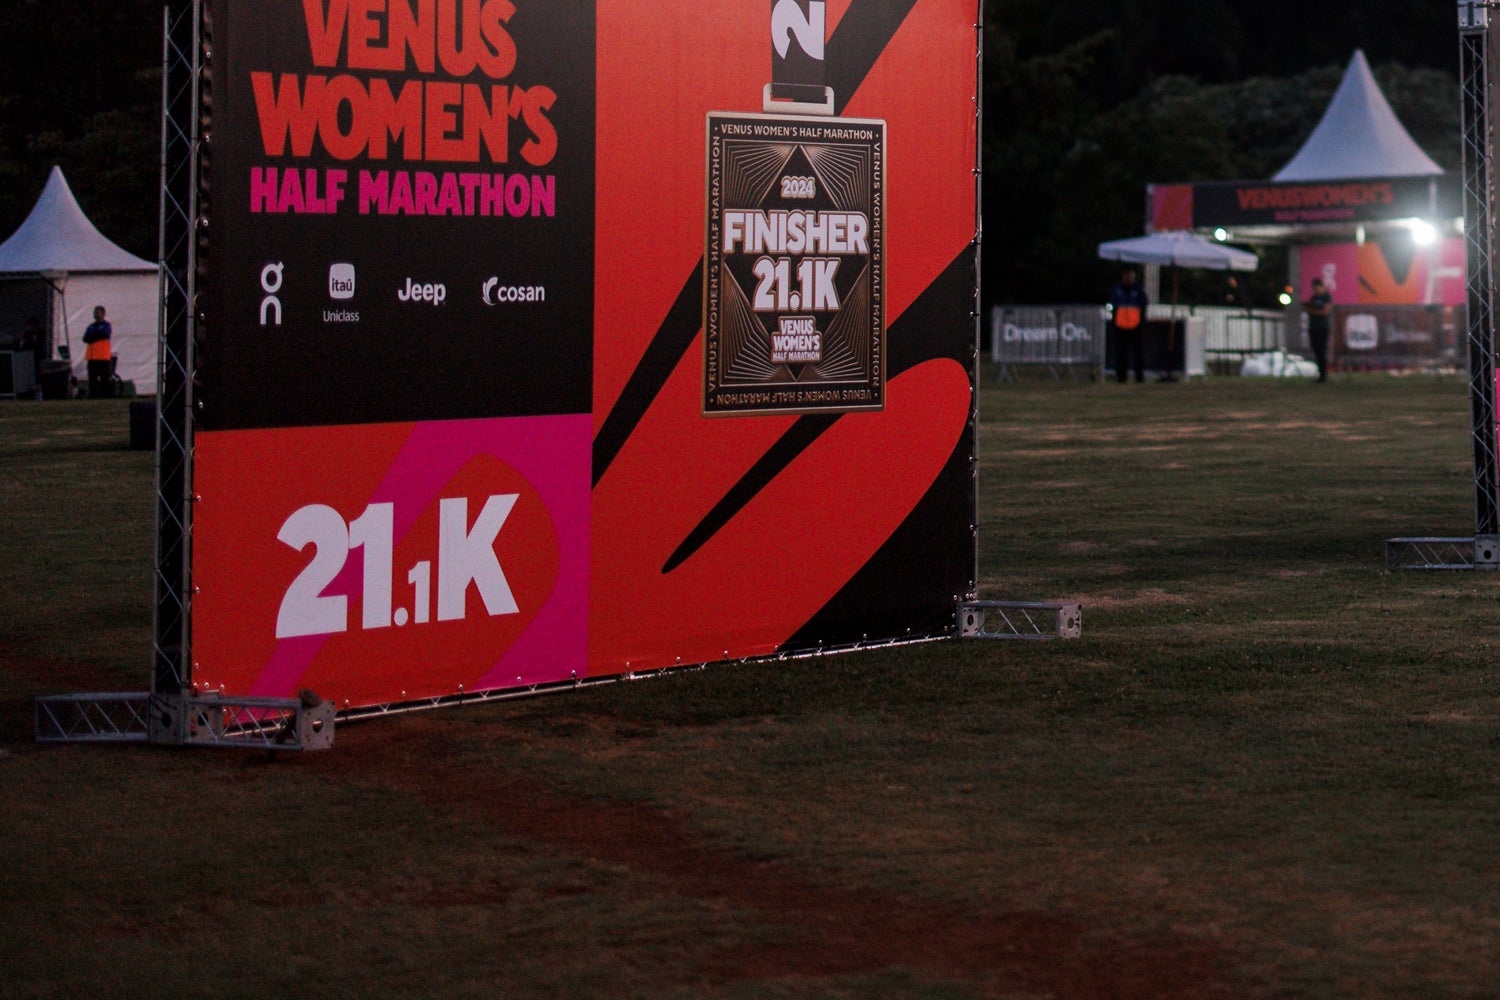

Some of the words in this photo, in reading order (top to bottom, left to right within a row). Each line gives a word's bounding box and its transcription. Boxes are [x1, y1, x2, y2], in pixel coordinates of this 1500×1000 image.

[250, 71, 558, 166] WOMEN'S
[721, 123, 752, 135] VENUS
[754, 125, 797, 137] WOMEN'S
[799, 127, 822, 138] HALF
[823, 128, 873, 140] MARATHON
[712, 136, 720, 220] MARATHON
[873, 142, 881, 192] VENUS
[250, 166, 348, 213] HALF
[359, 169, 556, 217] MARATHON
[782, 177, 815, 197] 2024
[710, 222, 719, 260] HALF
[723, 210, 869, 254] FINISHER
[873, 192, 881, 261] WOMEN'S
[398, 277, 446, 305] Jeep
[497, 283, 545, 302] cosan
[753, 257, 841, 311] 21.1K
[873, 263, 881, 299] HALF
[323, 310, 360, 322] Uniclass
[709, 264, 719, 338] WOMEN'S
[773, 334, 820, 351] WOMEN'S
[780, 318, 814, 335] VENUS
[872, 302, 880, 387] MARATHON
[1004, 323, 1058, 342] Dream
[708, 342, 717, 392] VENUS
[772, 351, 787, 361] HALF
[788, 351, 820, 361] MARATHON
[717, 393, 770, 404] MARATHON
[771, 392, 796, 403] HALF
[843, 389, 872, 400] VENUS
[275, 493, 520, 638] 21.1K
